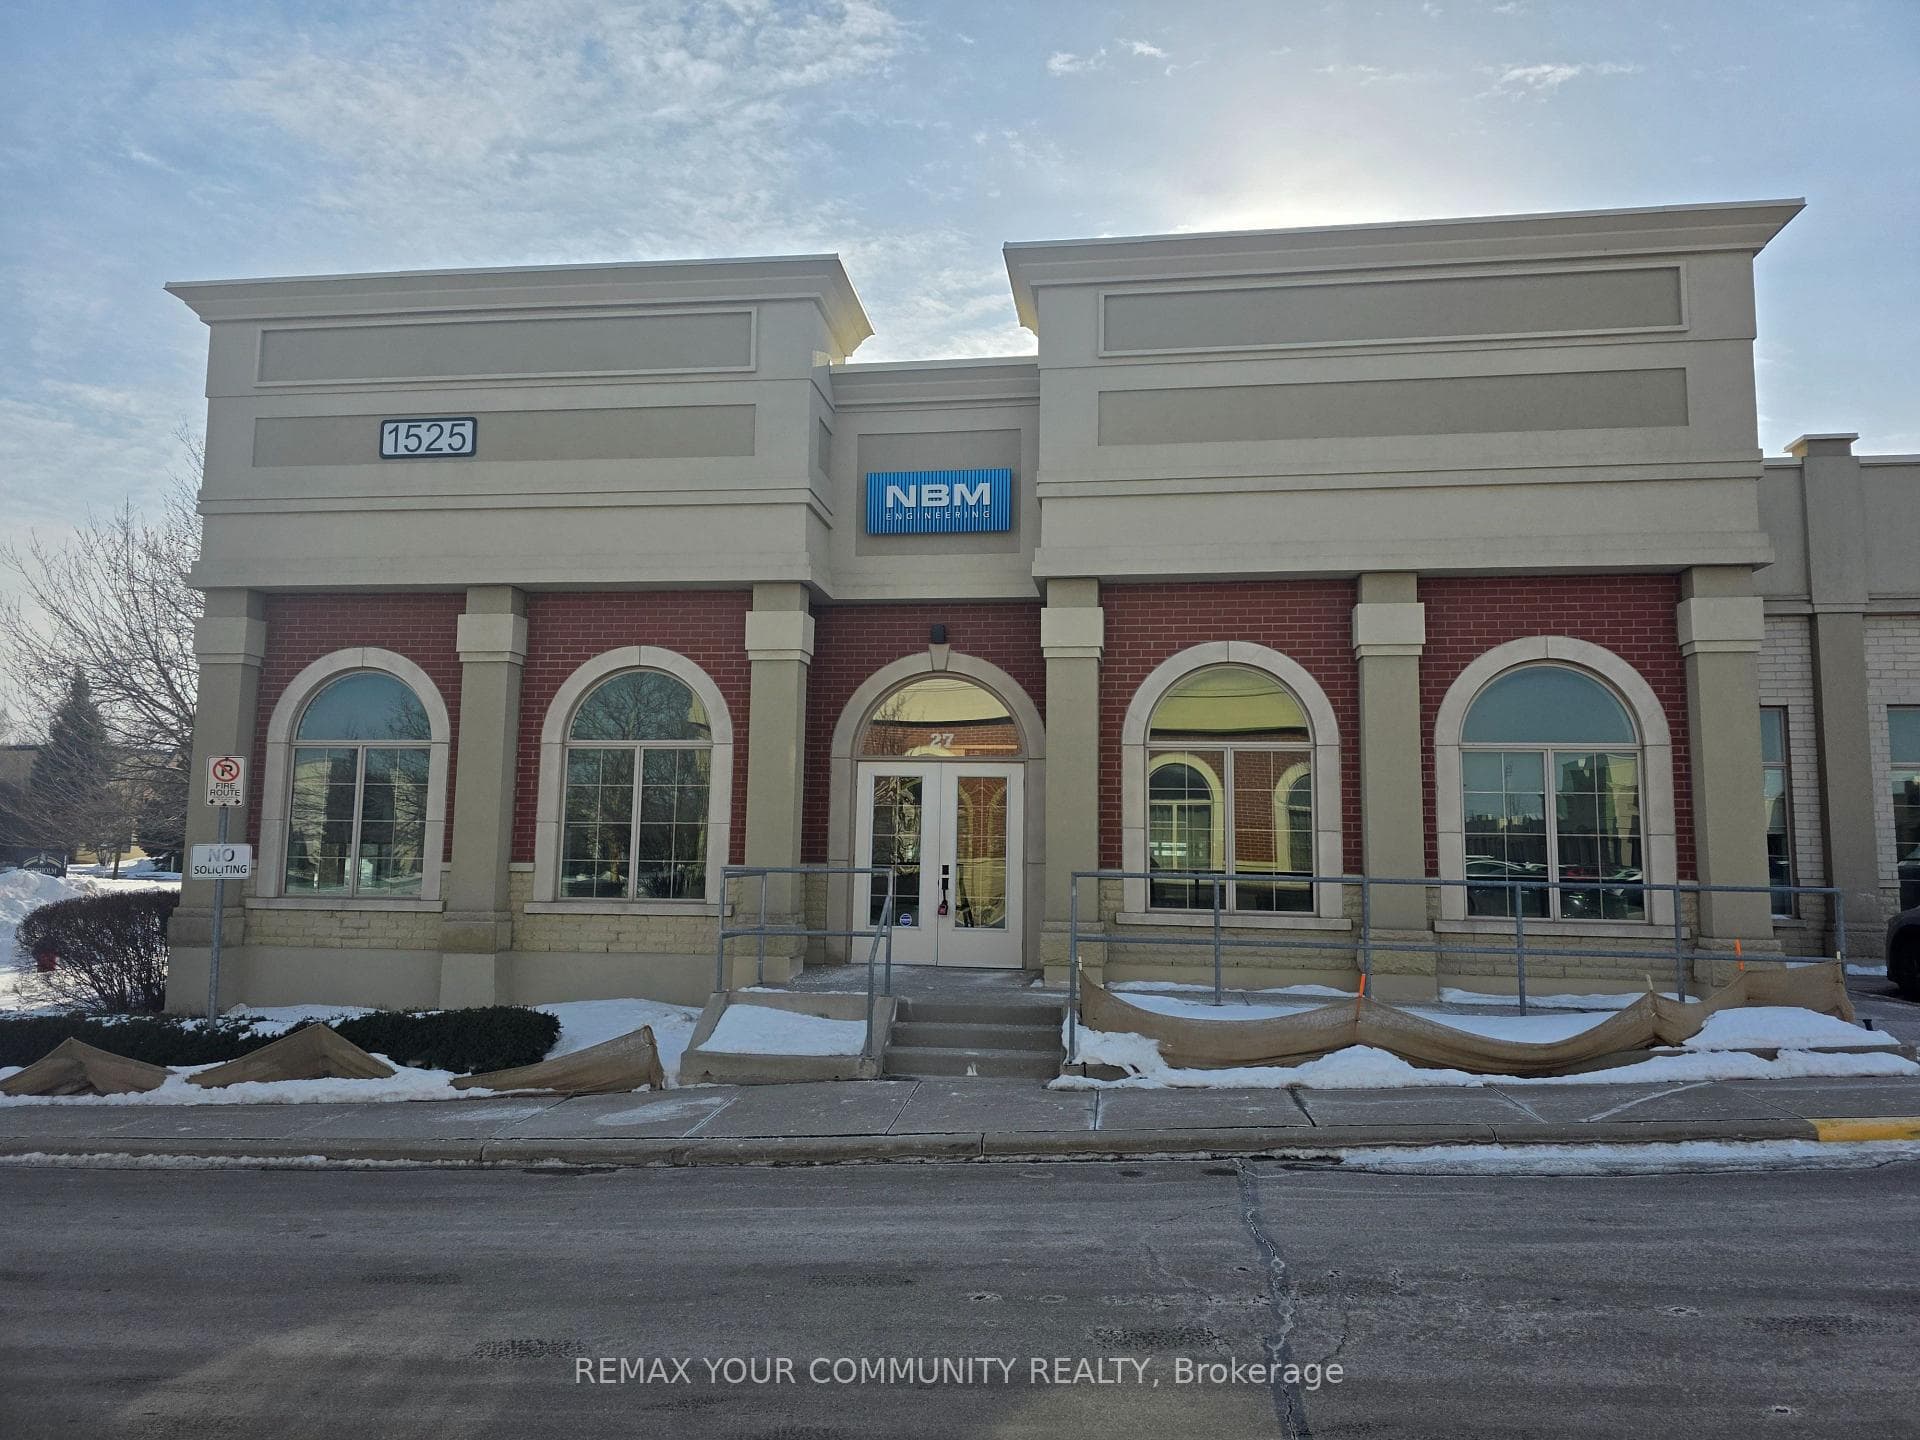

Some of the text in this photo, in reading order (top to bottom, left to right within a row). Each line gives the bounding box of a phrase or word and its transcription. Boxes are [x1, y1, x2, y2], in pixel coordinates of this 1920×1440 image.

[388, 423, 467, 453] 1525
[886, 483, 991, 508] NBM
[886, 511, 991, 521] ENGINEERING
[930, 733, 954, 749] 27
[210, 789, 240, 797] ROUTE
[208, 848, 235, 862] NO
[193, 865, 248, 875] SOLICITING
